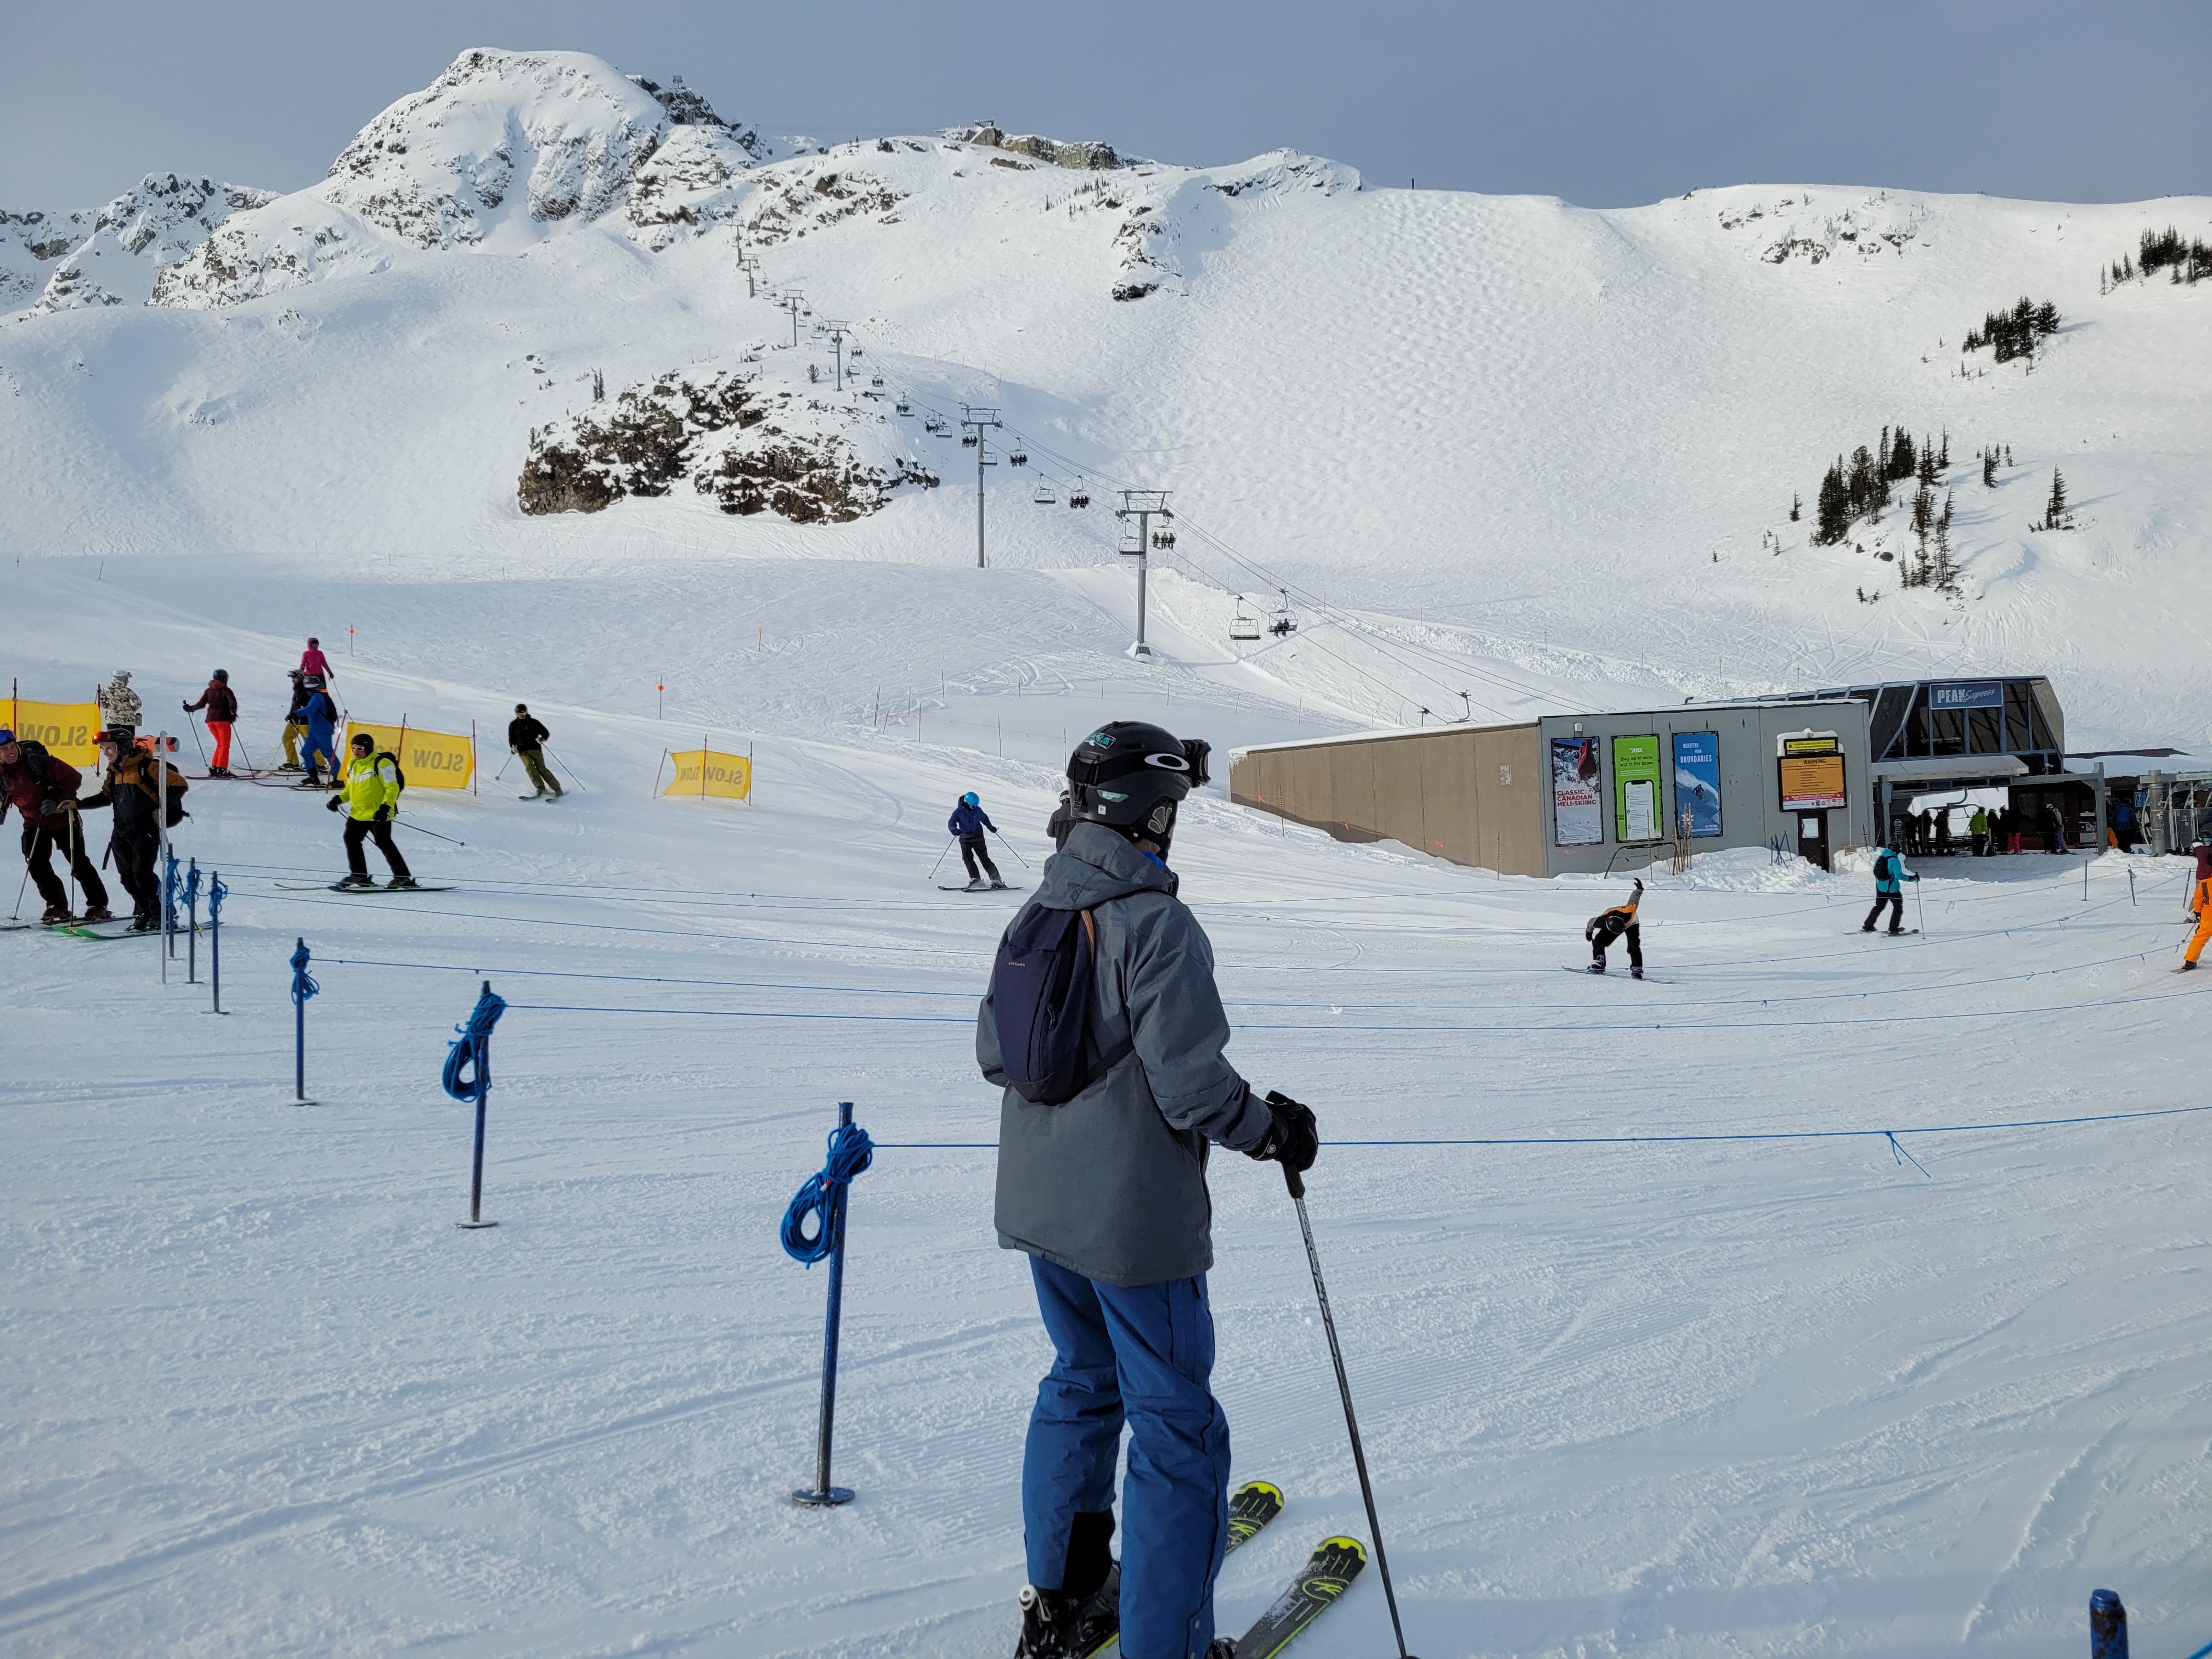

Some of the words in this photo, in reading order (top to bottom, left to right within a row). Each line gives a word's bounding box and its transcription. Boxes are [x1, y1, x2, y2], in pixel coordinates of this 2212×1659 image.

[1937, 689, 1966, 703] PEAK
[1963, 689, 1996, 702] Express
[1680, 755, 1712, 764] BOUNDARIES
